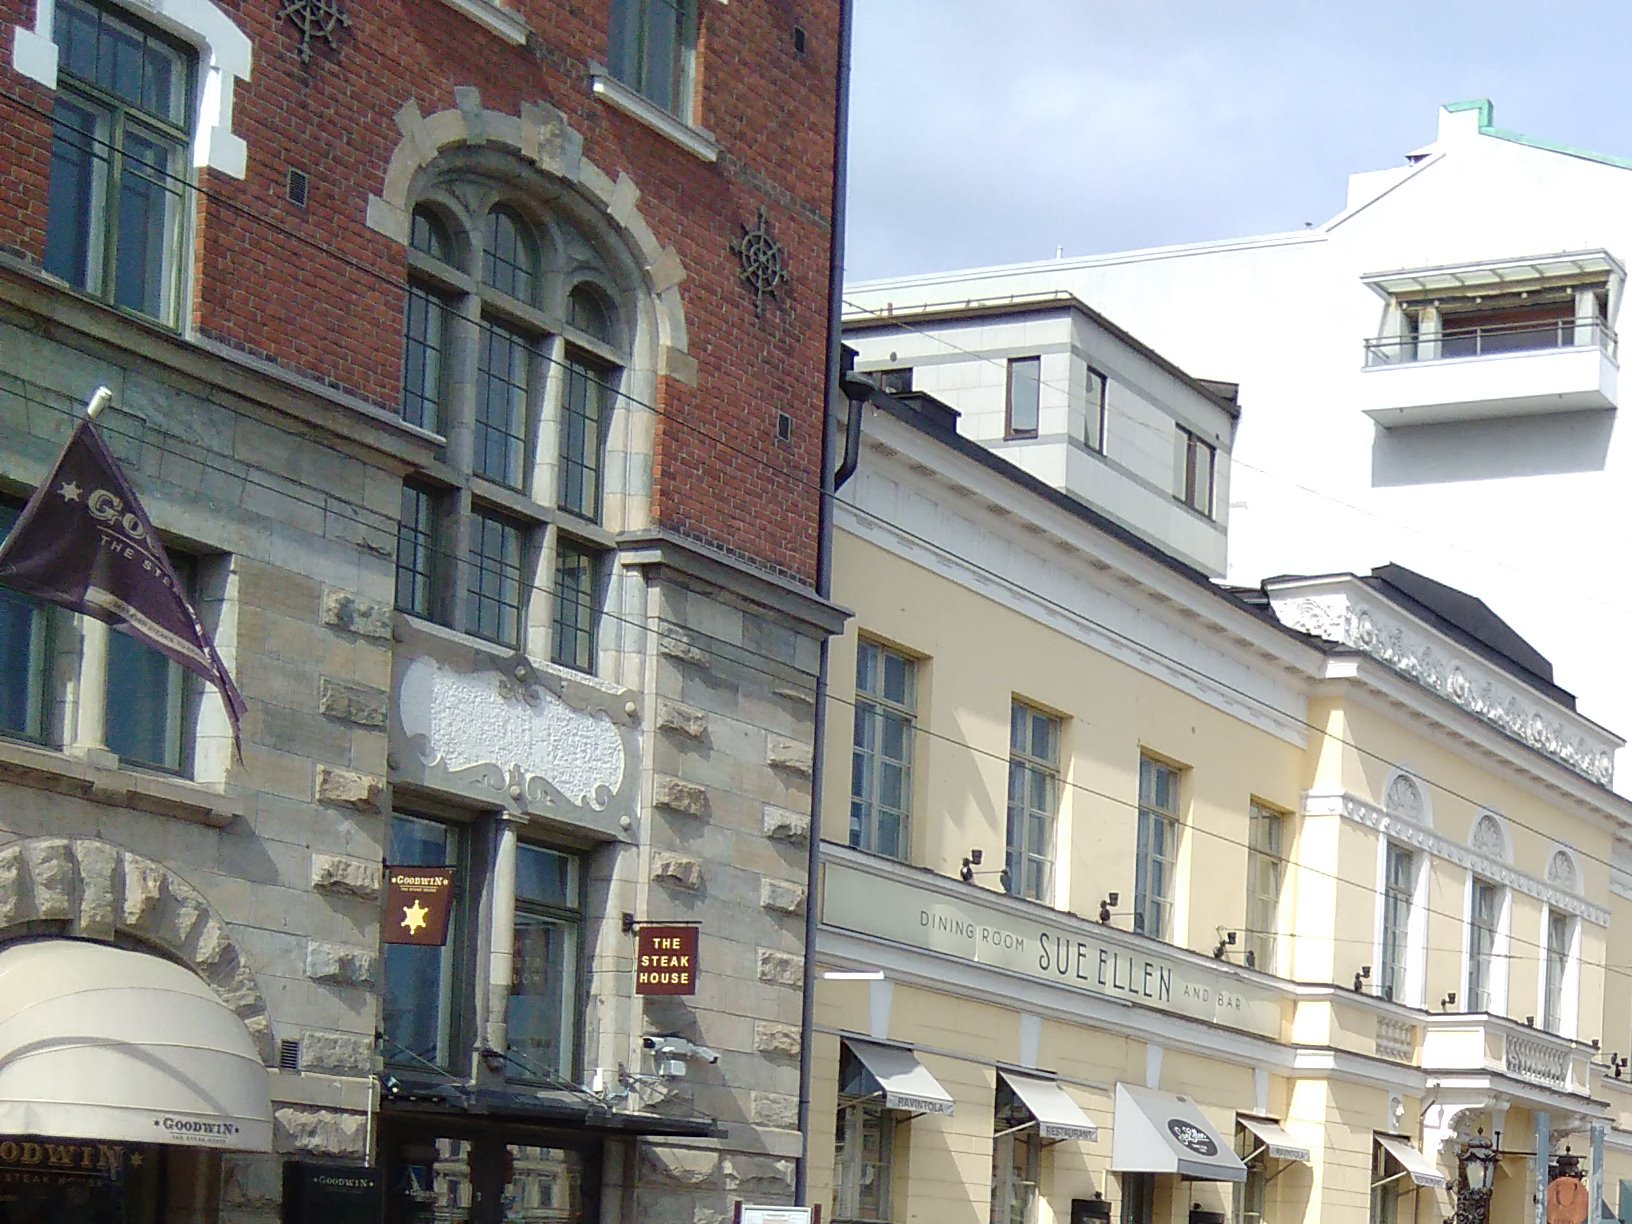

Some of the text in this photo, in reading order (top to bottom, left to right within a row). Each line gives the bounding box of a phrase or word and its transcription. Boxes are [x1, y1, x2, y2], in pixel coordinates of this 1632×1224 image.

[100, 535, 134, 560] THE
[397, 875, 443, 885] GOODWIN
[653, 937, 681, 950] THE
[641, 955, 690, 967] STEAK
[920, 909, 1243, 1011] DINING ROOM SUE ELLEN AND BAR
[639, 972, 690, 984] HOUSE
[898, 1096, 944, 1113] RAVINTOLA
[163, 1117, 233, 1135] GOODWIN
[1046, 1125, 1092, 1140] RESTAURANT
[320, 1175, 368, 1187] GOODWIN
